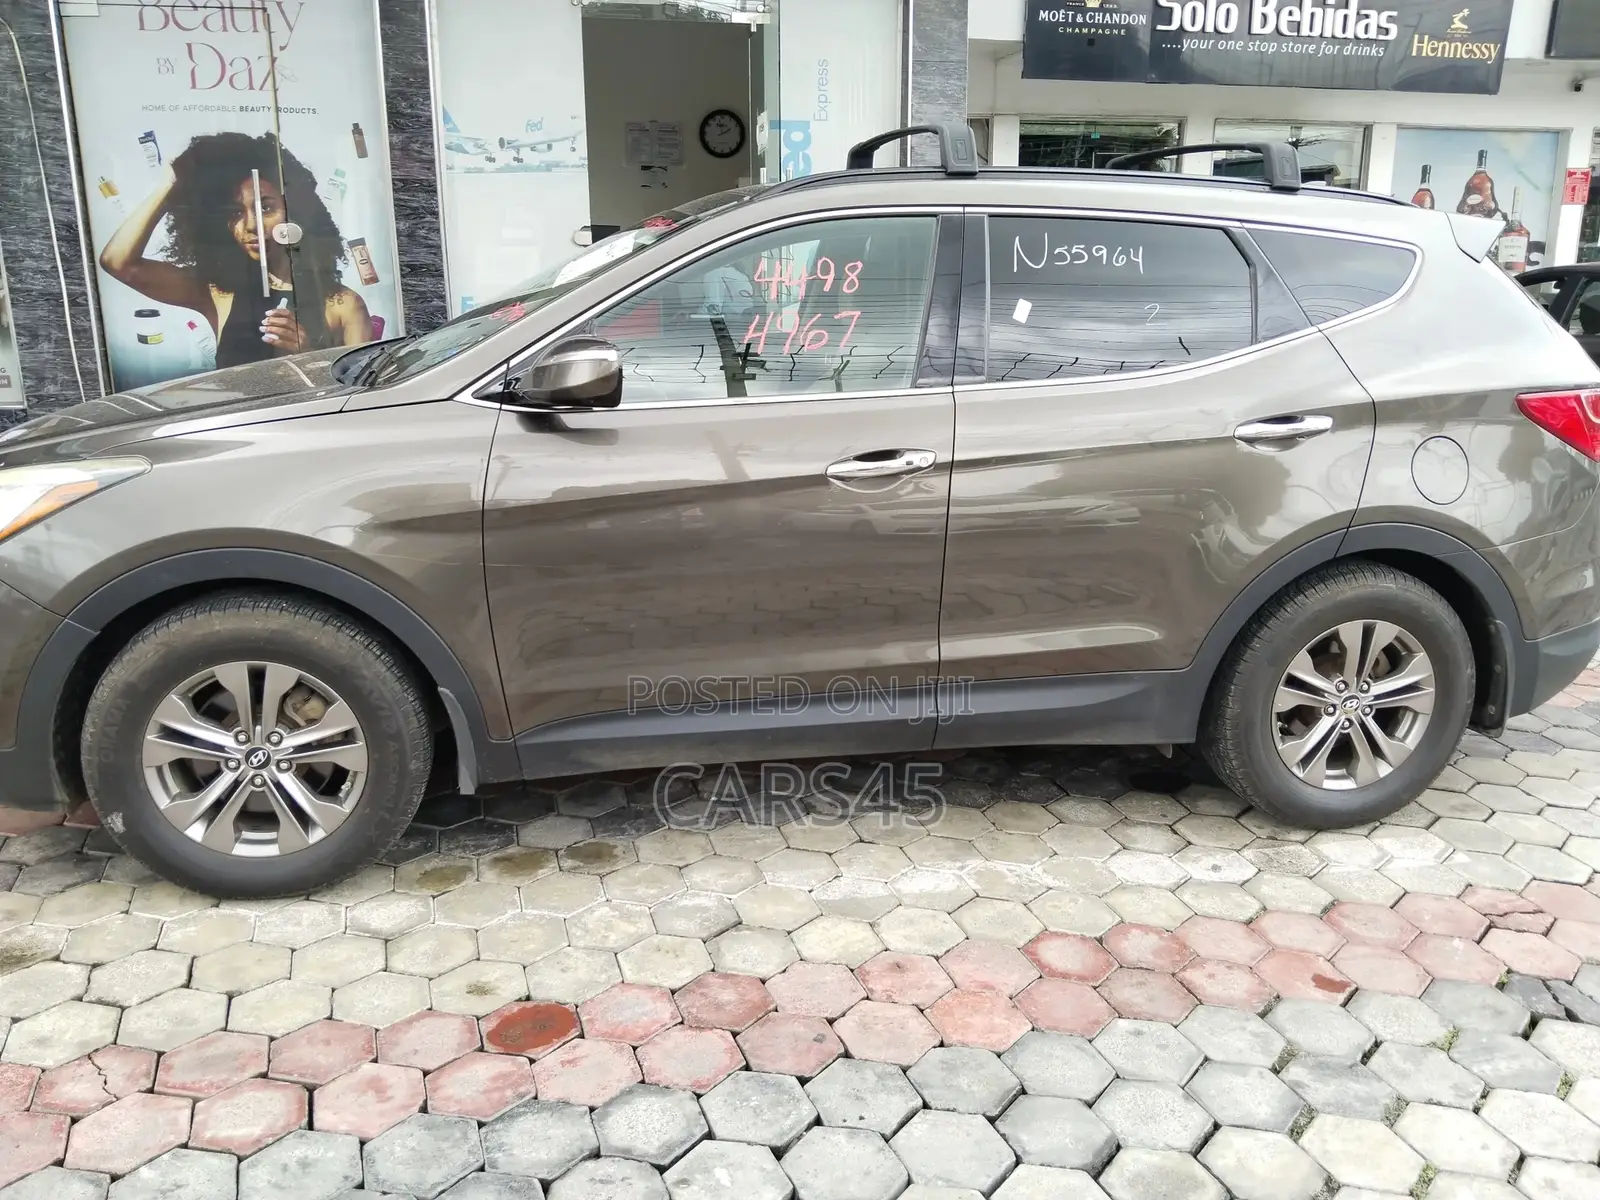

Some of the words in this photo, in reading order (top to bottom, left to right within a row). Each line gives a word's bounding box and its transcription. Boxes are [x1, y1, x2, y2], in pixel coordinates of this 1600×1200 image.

[138, 0, 304, 51] Beauty
[1058, 26, 1127, 36] CHAMPAGNE
[1076, 13, 1084, 23] &
[1085, 11, 1148, 26] CHANDON
[1155, 0, 1240, 34] Solo
[1250, 0, 1398, 40] Bebidas
[156, 57, 178, 75] BY
[185, 42, 280, 91] Daz
[1217, 39, 1243, 51] one
[1246, 37, 1278, 53] stop
[1281, 40, 1316, 55] store
[1318, 39, 1341, 58] for
[1343, 42, 1385, 58] drinks
[1411, 34, 1501, 64] Hennessy
[141, 104, 167, 112] HOME
[168, 104, 181, 112] OF
[182, 104, 238, 113] AFFORDABLE
[239, 105, 272, 113] BEAUTY
[275, 106, 320, 115] RODUCTS.
[813, 58, 832, 122] Express
[769, 120, 812, 183] ed
[1013, 232, 1144, 274] N55964
[753, 256, 864, 301] 4498
